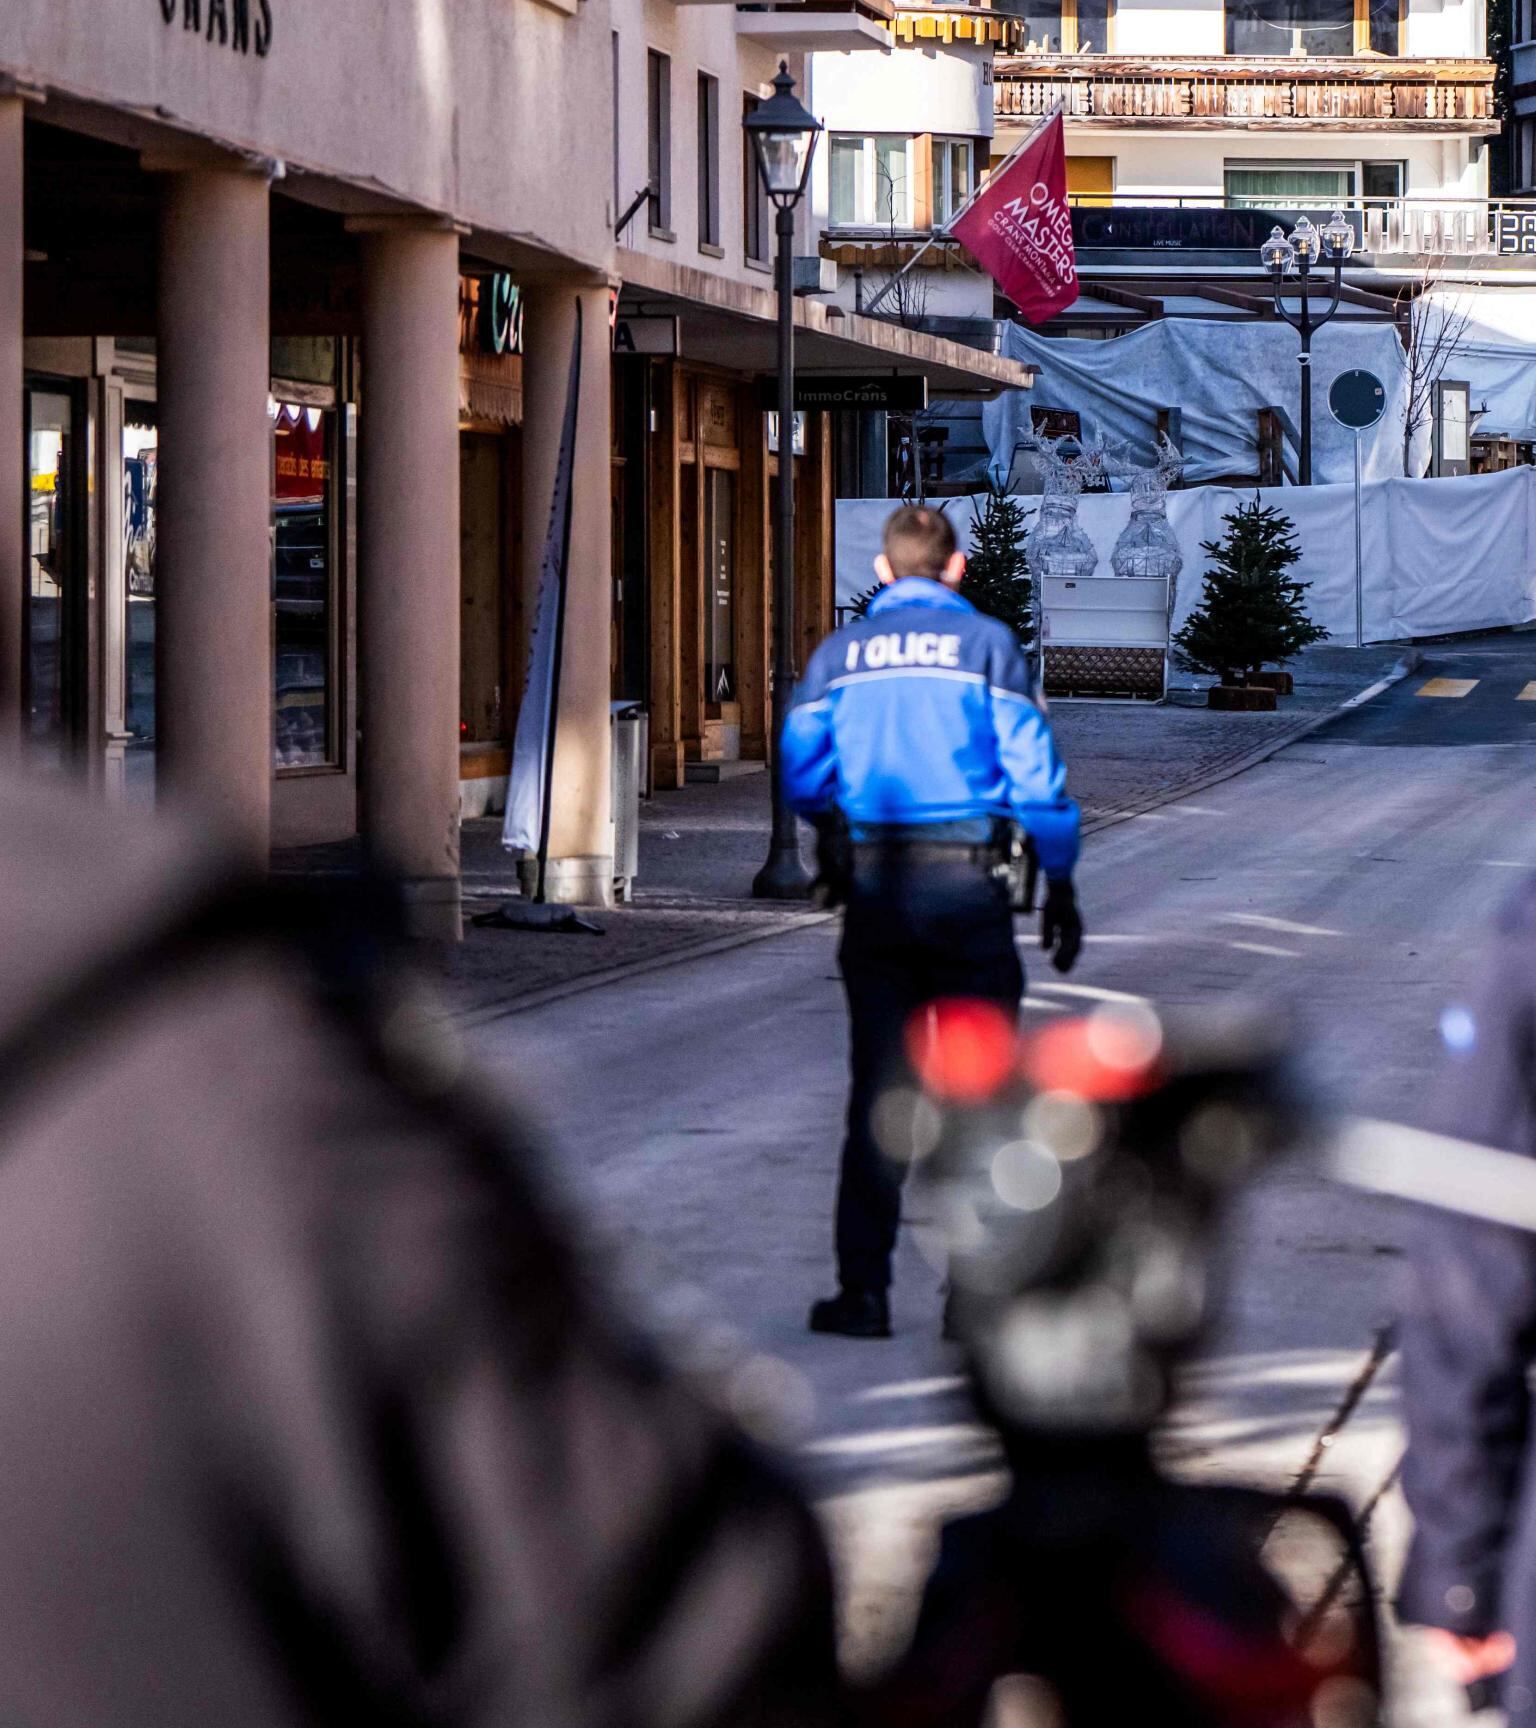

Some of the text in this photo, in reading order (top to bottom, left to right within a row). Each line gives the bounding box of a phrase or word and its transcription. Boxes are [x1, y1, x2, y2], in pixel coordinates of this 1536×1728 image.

[994, 211, 1025, 244] CRANS
[1003, 197, 1076, 285] MASTERS
[1030, 182, 1075, 252] OMEG
[798, 389, 888, 401] ImmoCrans
